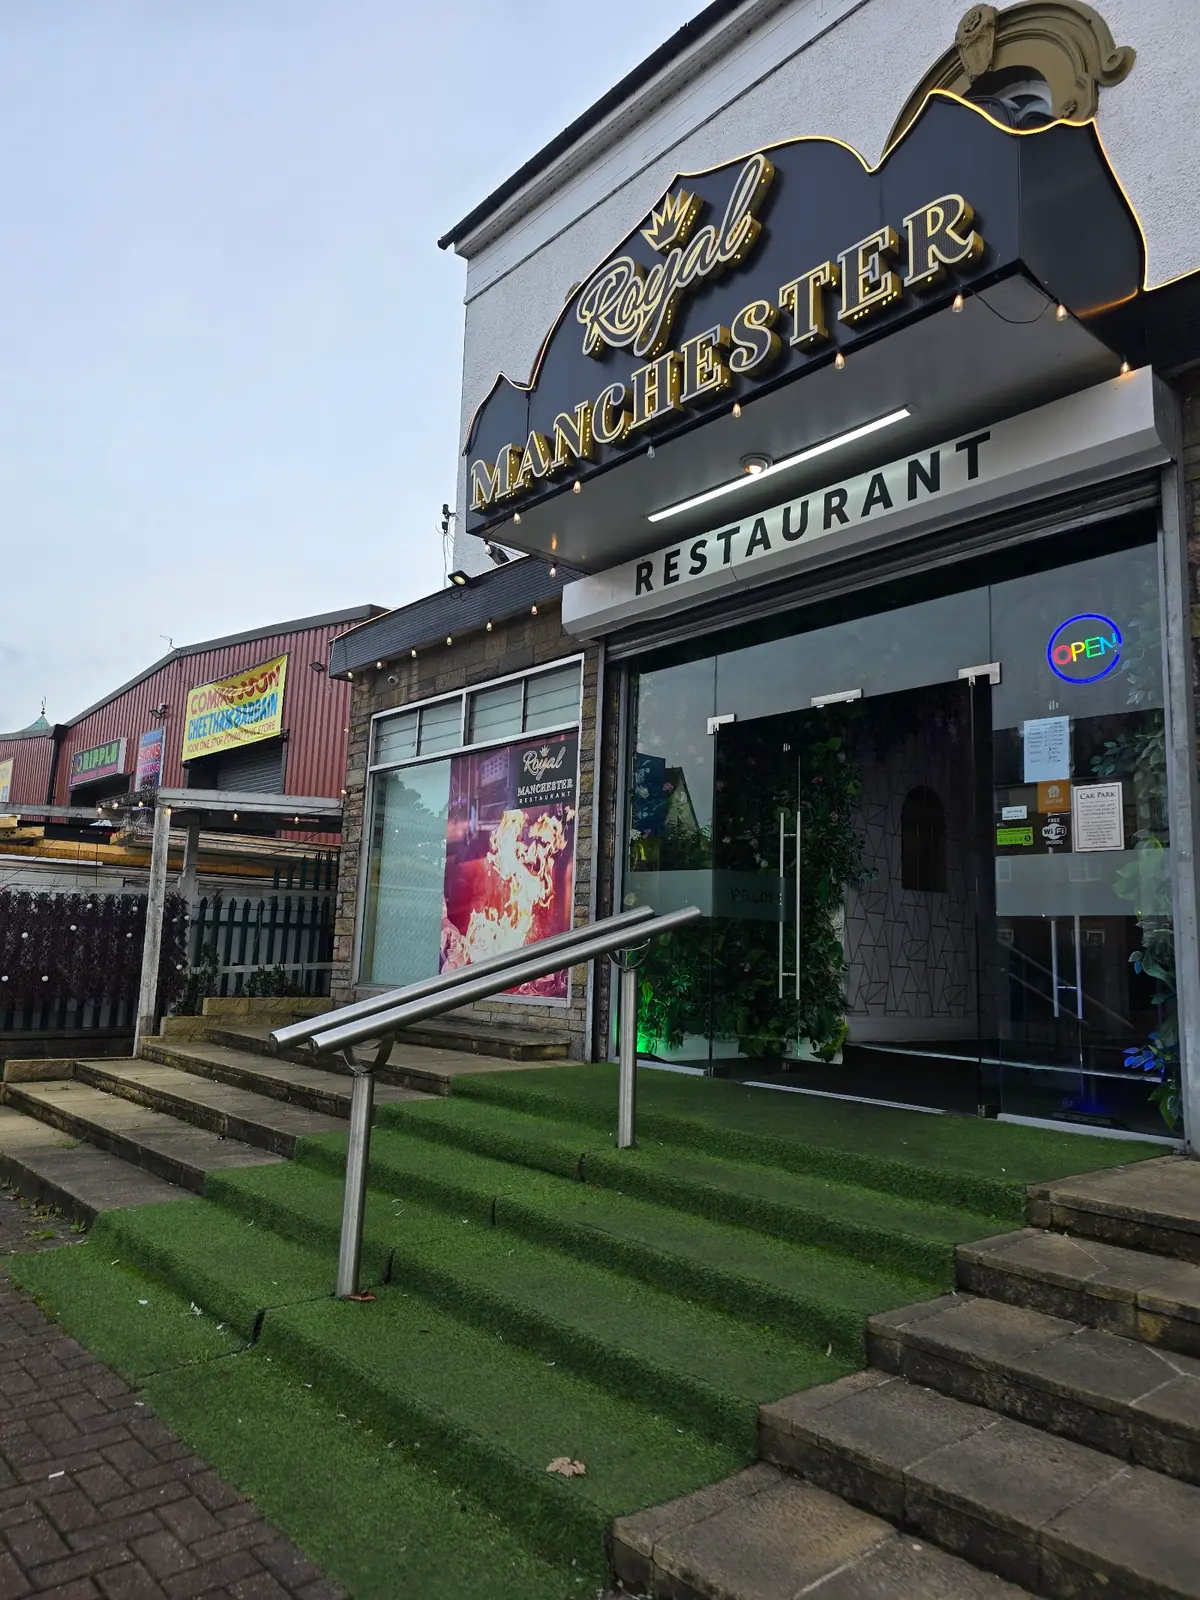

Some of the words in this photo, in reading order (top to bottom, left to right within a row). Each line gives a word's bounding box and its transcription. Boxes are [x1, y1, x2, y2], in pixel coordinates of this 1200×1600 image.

[577, 154, 772, 356] Royal
[469, 193, 983, 513] MANCHESTER
[634, 432, 990, 596] RESTAURANT
[1053, 632, 1117, 665] OPEN
[523, 746, 566, 781] Royal
[517, 778, 573, 797] MANCHESTER
[519, 790, 571, 804] RESTAURANT
